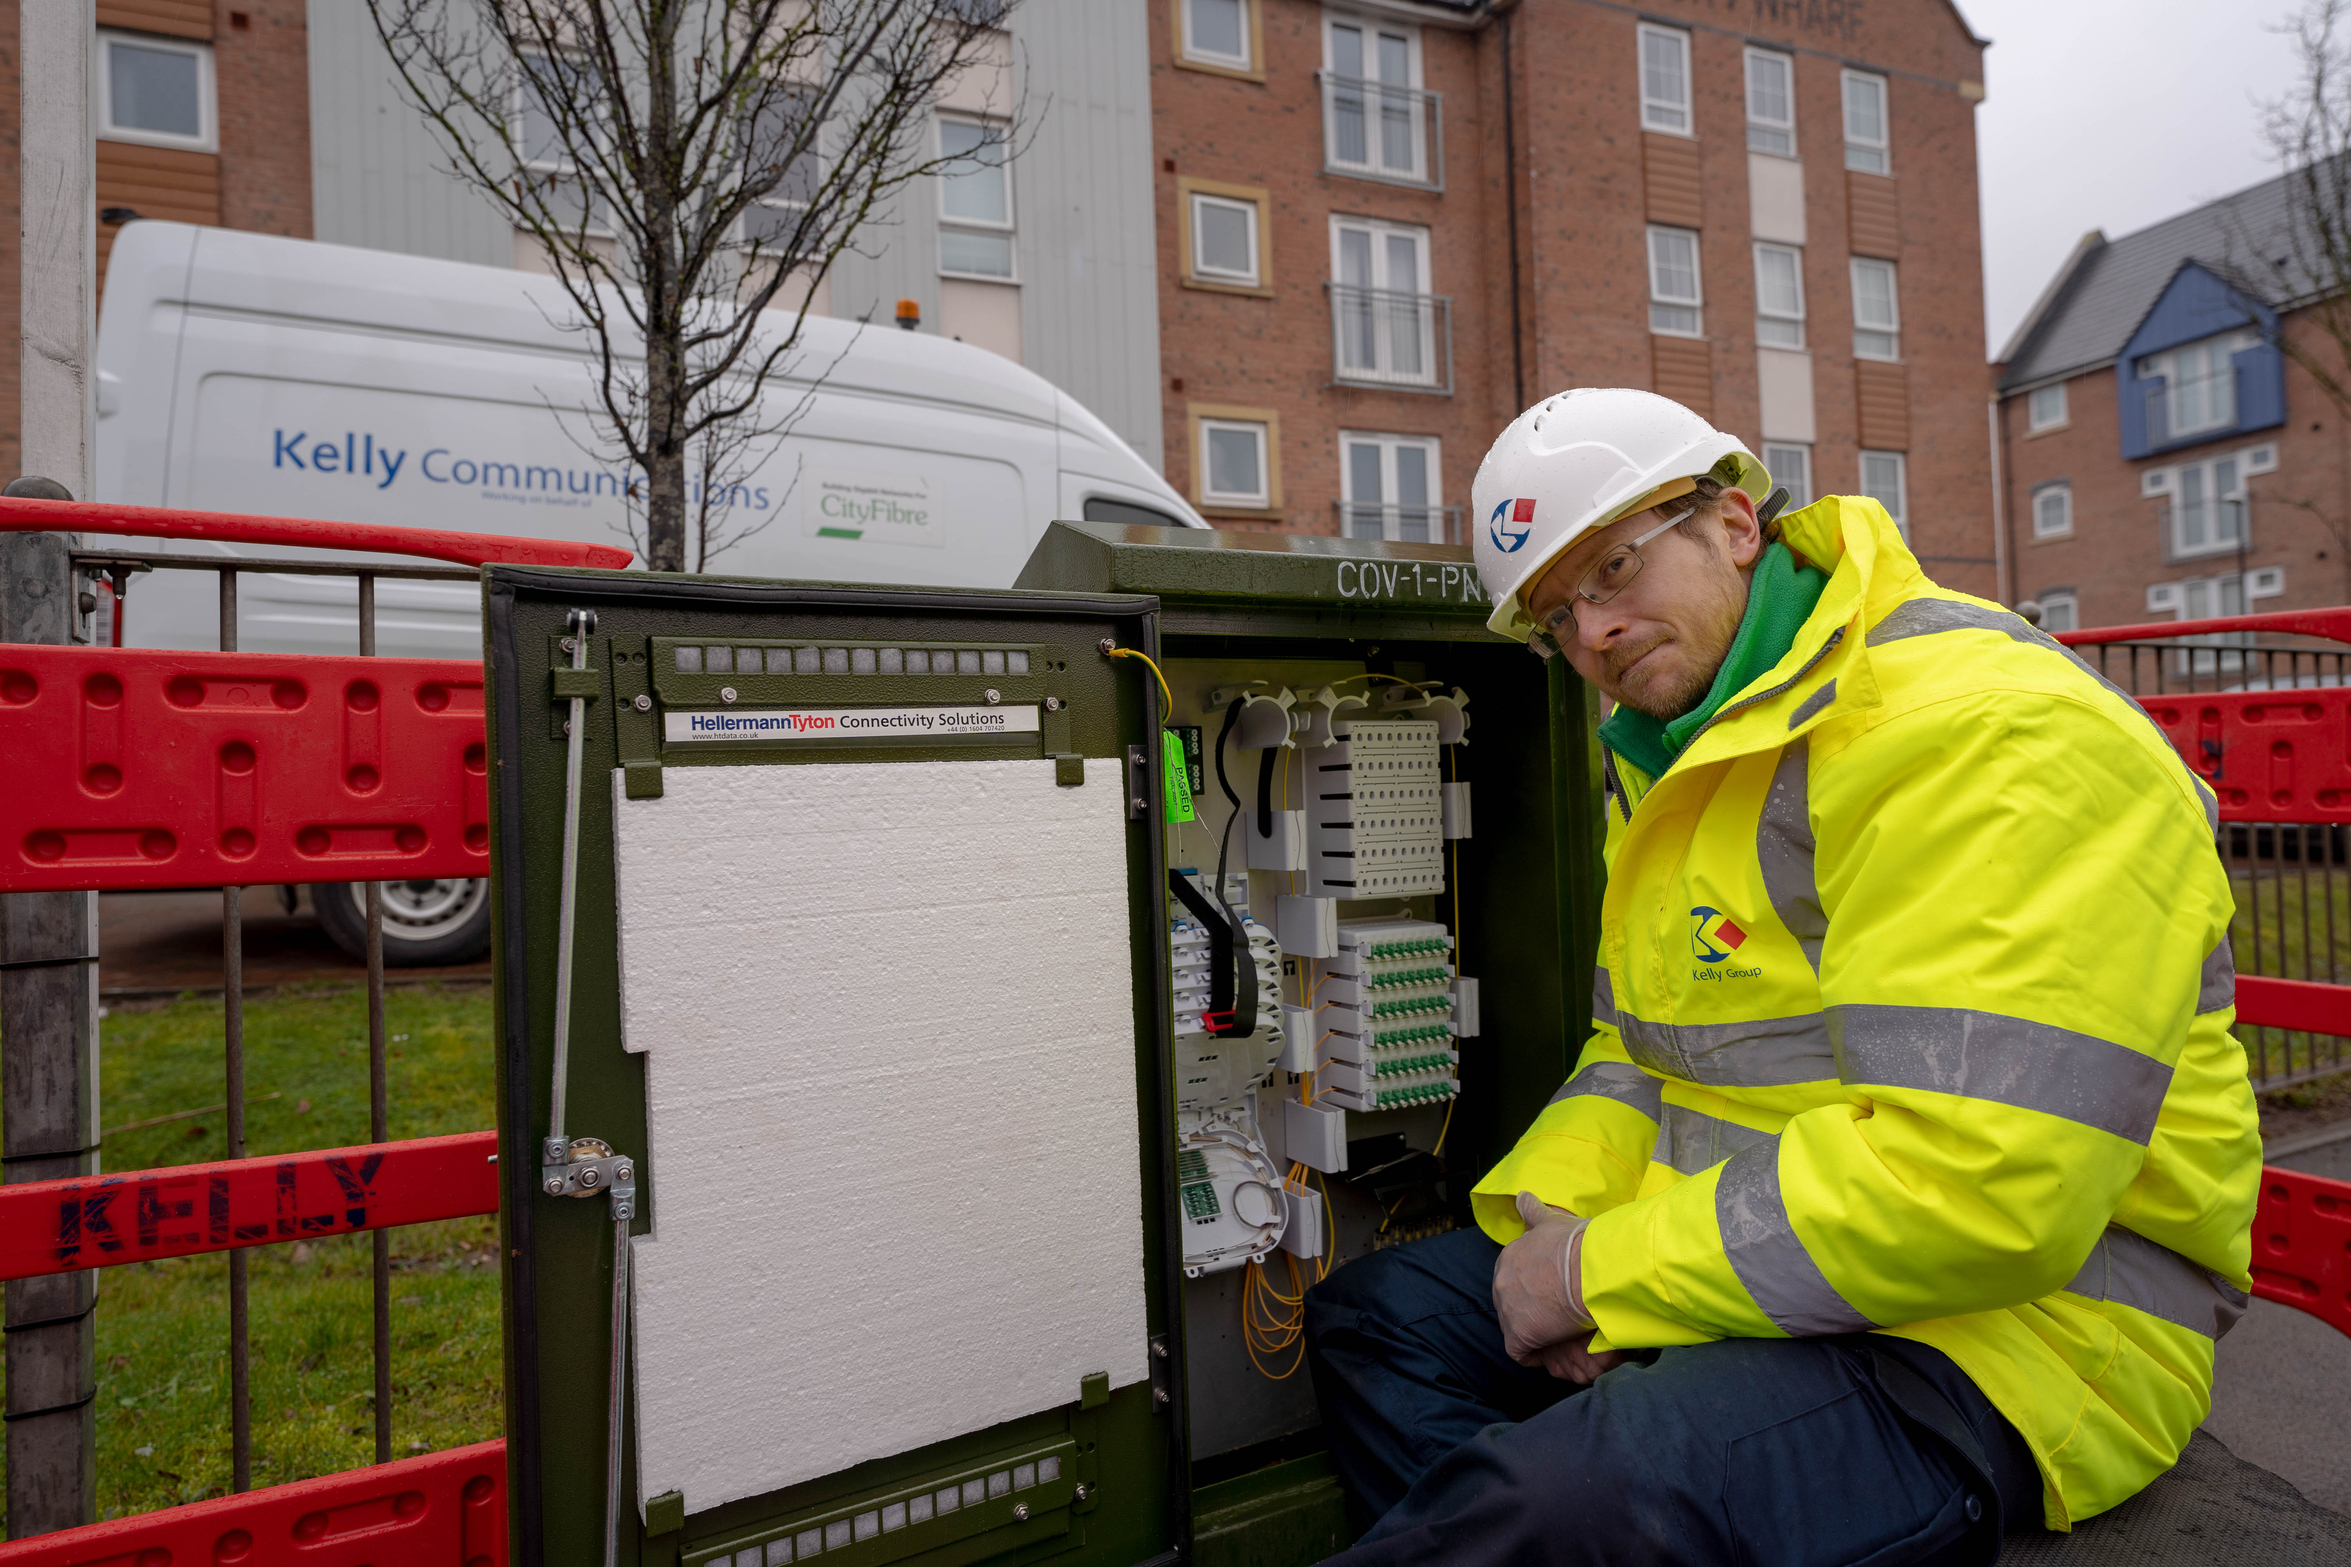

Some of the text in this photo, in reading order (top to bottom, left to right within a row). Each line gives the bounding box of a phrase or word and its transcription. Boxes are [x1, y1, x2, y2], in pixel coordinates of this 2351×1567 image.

[273, 428, 770, 510] Kelly Communicions
[820, 493, 929, 526] CityFibre
[1337, 561, 1491, 602] COV-1-PN
[691, 712, 1005, 733] HellermannTyton Connectivity Solutions
[692, 732, 759, 740] www.htdata.co.uk
[1176, 767, 1190, 812] PASSED
[1692, 967, 1762, 982] Kelly Group
[57, 1152, 387, 1267] KELLY
